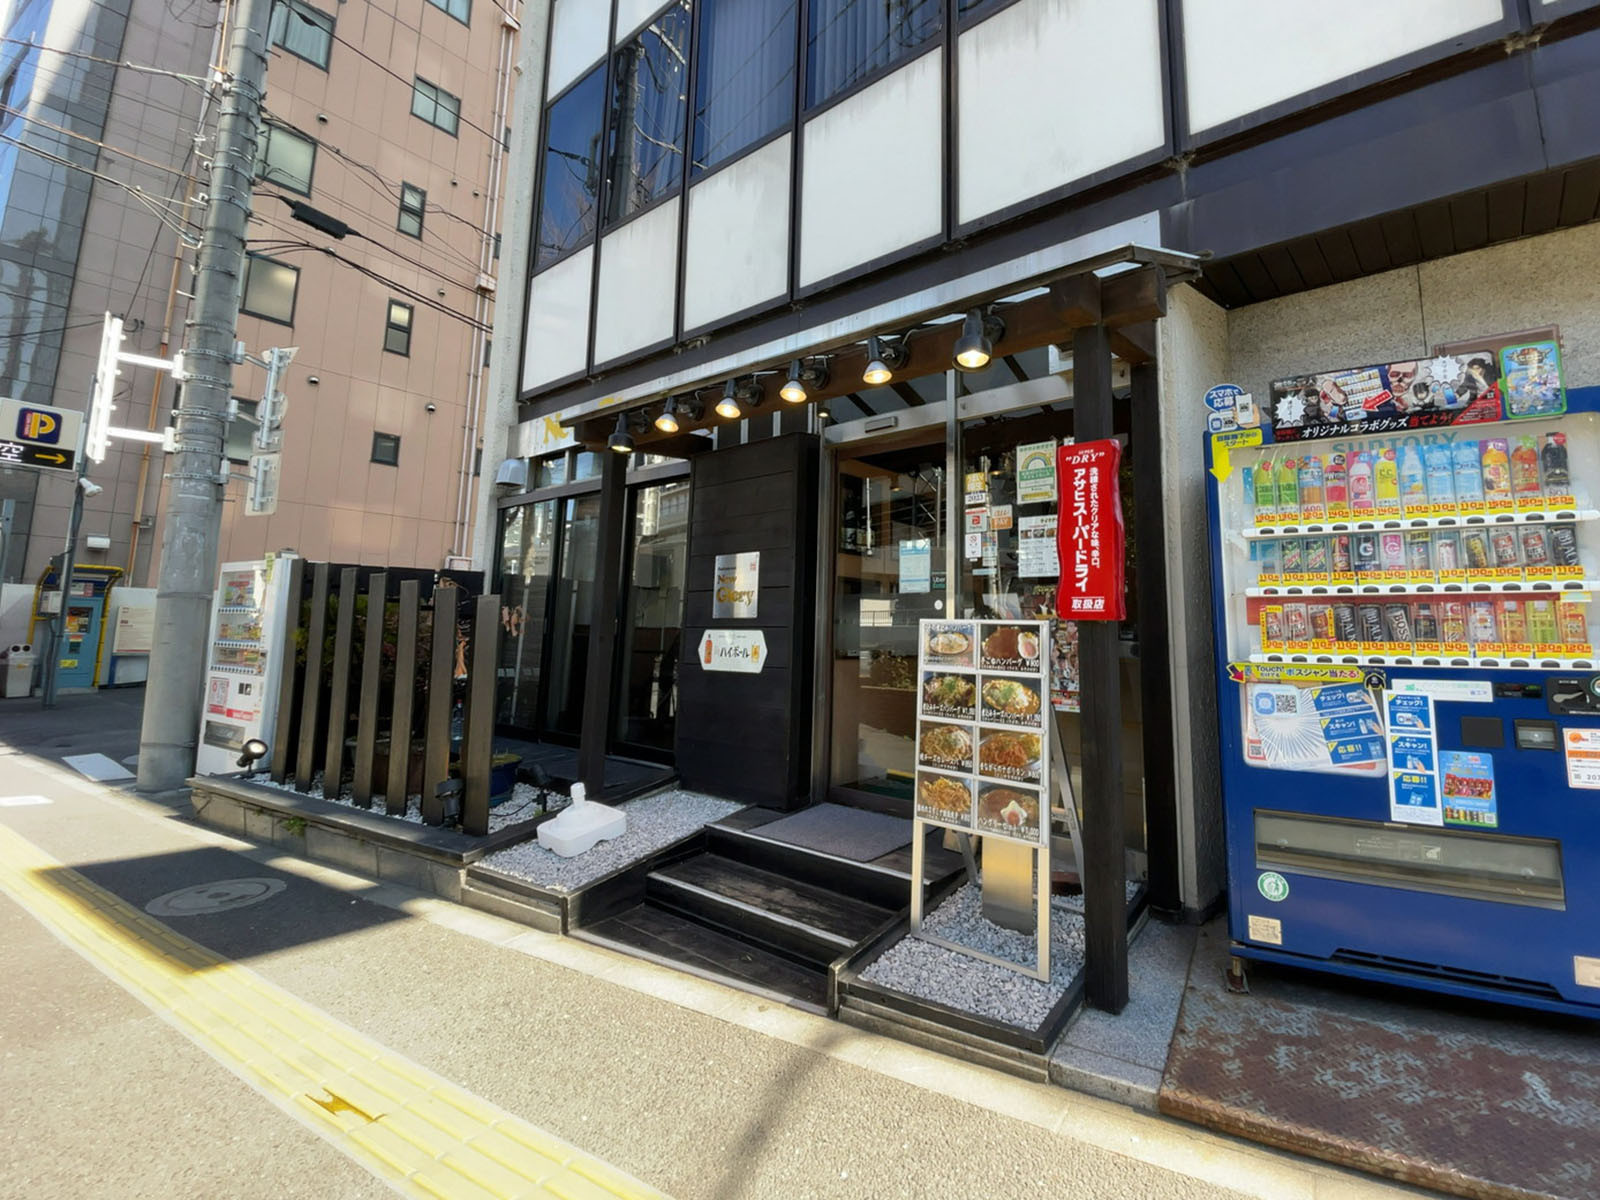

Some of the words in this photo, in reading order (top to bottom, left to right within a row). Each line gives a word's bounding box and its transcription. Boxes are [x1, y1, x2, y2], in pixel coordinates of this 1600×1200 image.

[1210, 389, 1239, 398] スマホで
[1214, 397, 1234, 407] 応募
[1302, 417, 1408, 439] オリジナルコラボグッズ
[0, 442, 24, 463] 空
[1072, 468, 1089, 592] アサヒスーパードライ
[716, 587, 755, 608] Glory
[1071, 598, 1105, 610] 取扱店
[1393, 611, 1409, 641] BOSS
[720, 646, 750, 658] ハイボール
[1286, 667, 1360, 679] ボスジャン当たる!
[1319, 692, 1345, 702] チェック!
[1329, 722, 1356, 730] スキャン!
[1337, 745, 1362, 754] 応募!!
[1398, 741, 1428, 749] スキャン!
[1402, 775, 1428, 784] 応募!!
